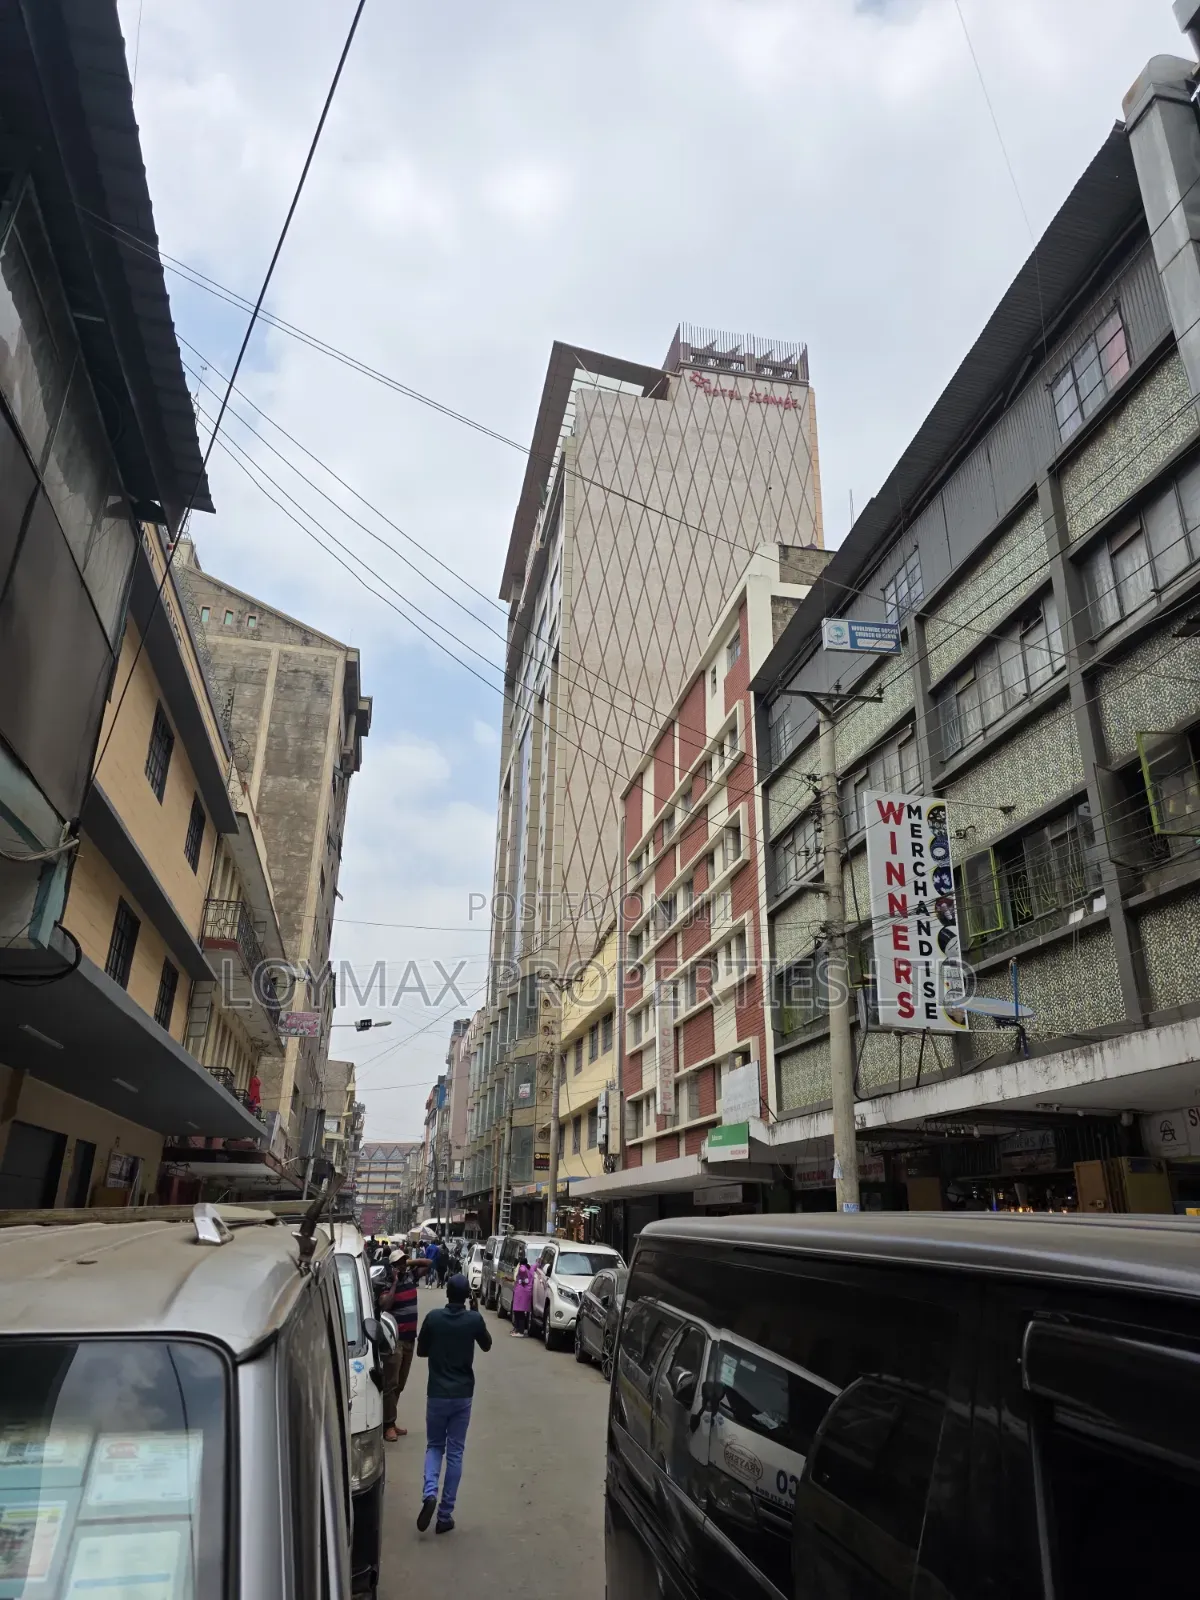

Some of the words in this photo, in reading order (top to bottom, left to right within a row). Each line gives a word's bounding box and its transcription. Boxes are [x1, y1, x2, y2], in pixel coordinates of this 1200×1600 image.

[703, 386, 741, 400] HOTEL
[876, 799, 915, 1019] WINNERS
[906, 803, 938, 1020] MERCHANDISE
